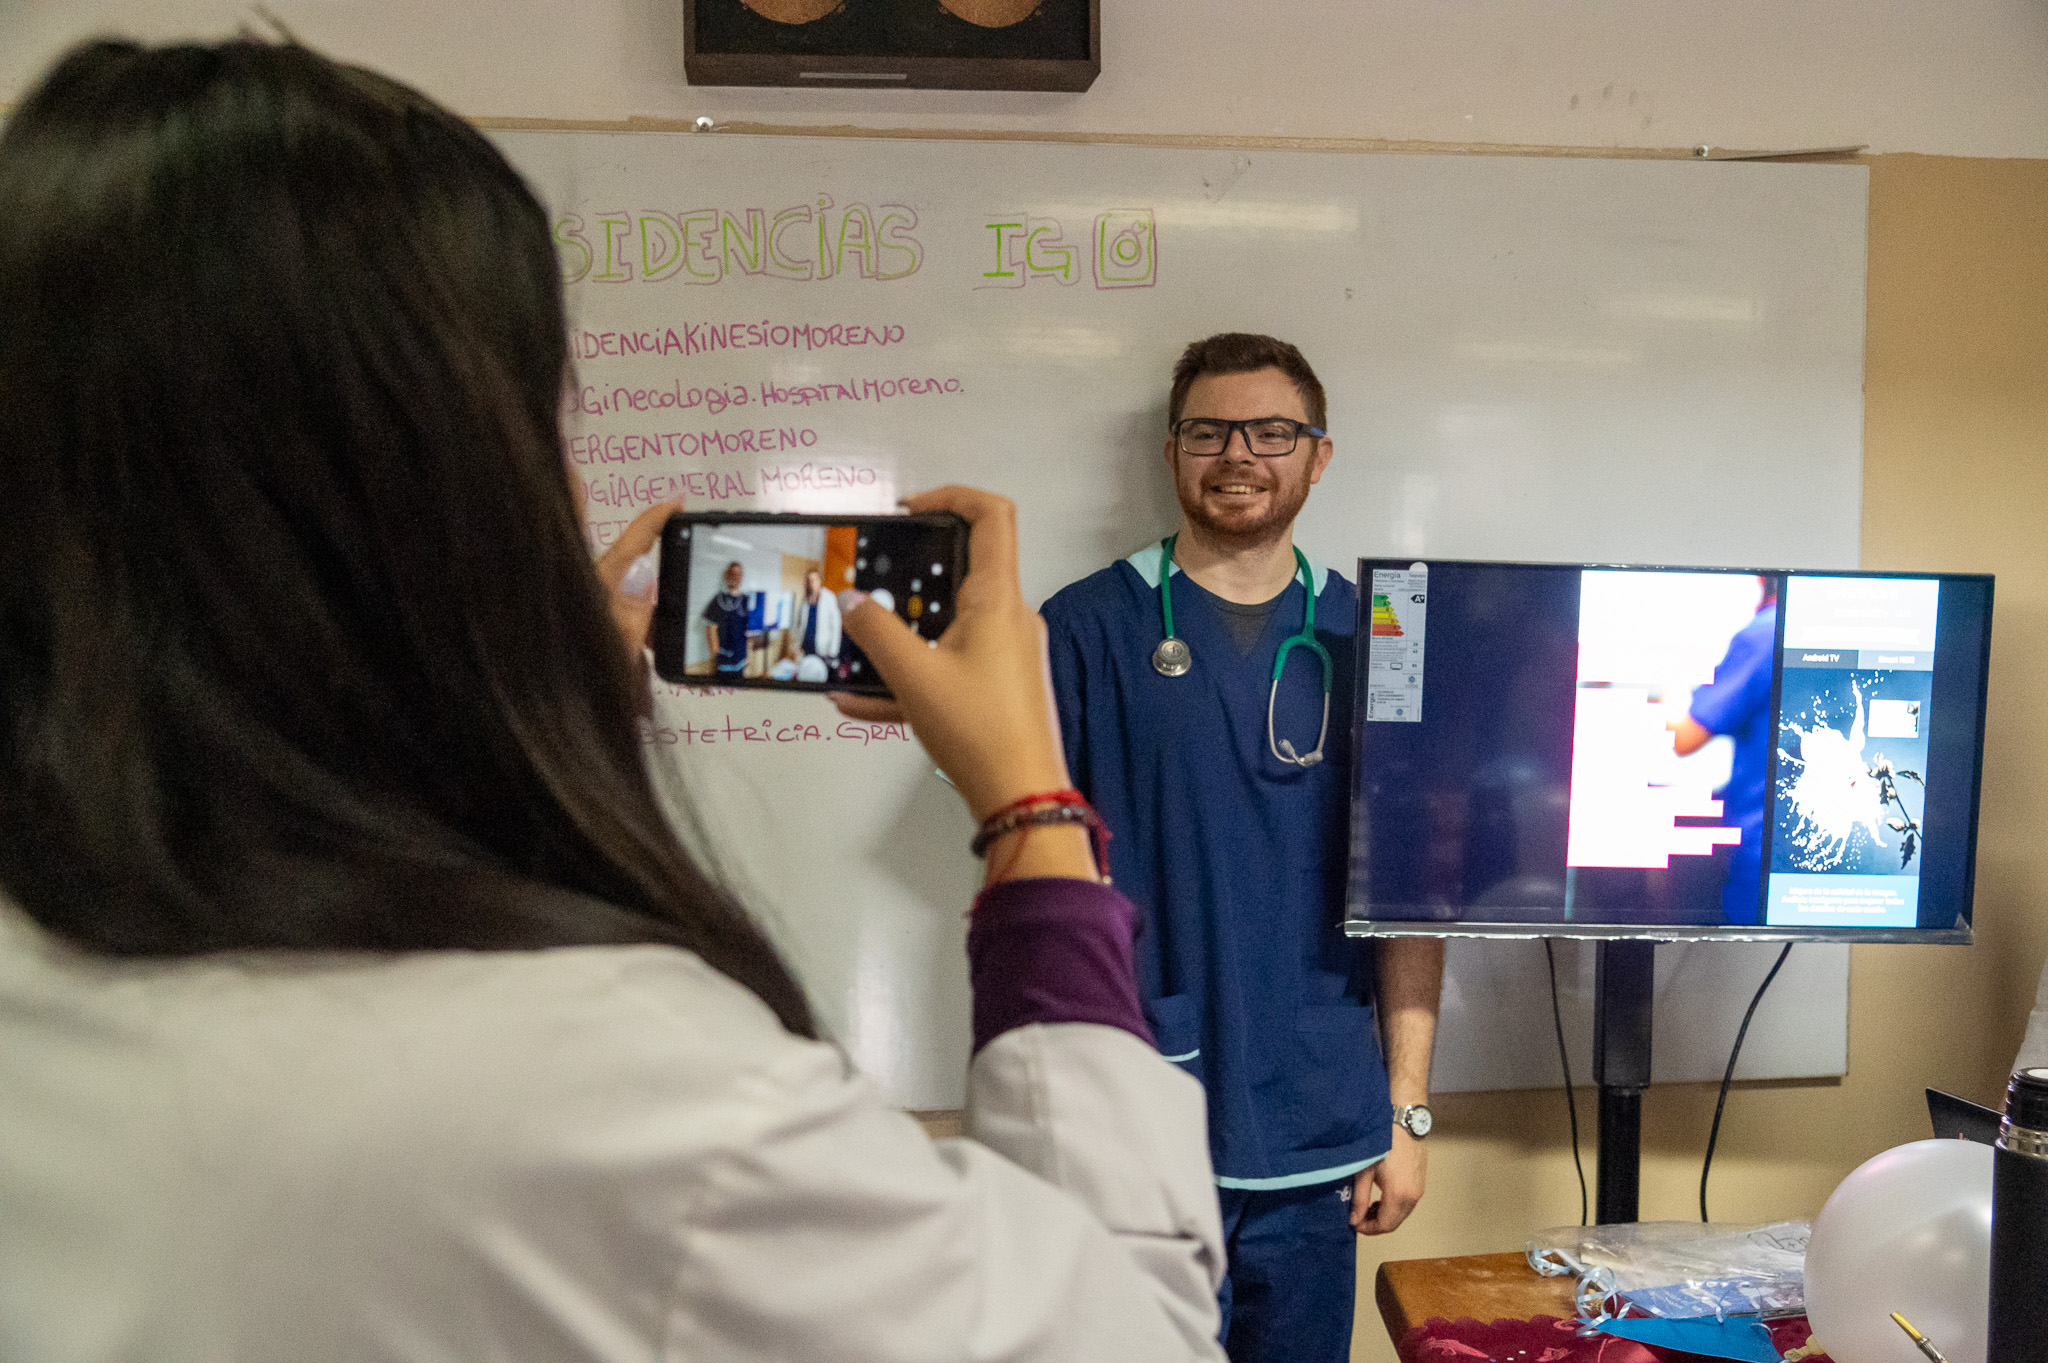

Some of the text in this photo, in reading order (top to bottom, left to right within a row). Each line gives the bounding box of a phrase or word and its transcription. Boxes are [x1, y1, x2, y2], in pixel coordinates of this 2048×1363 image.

[760, 462, 877, 495] MORENO
[1802, 653, 1840, 663] Android TV
